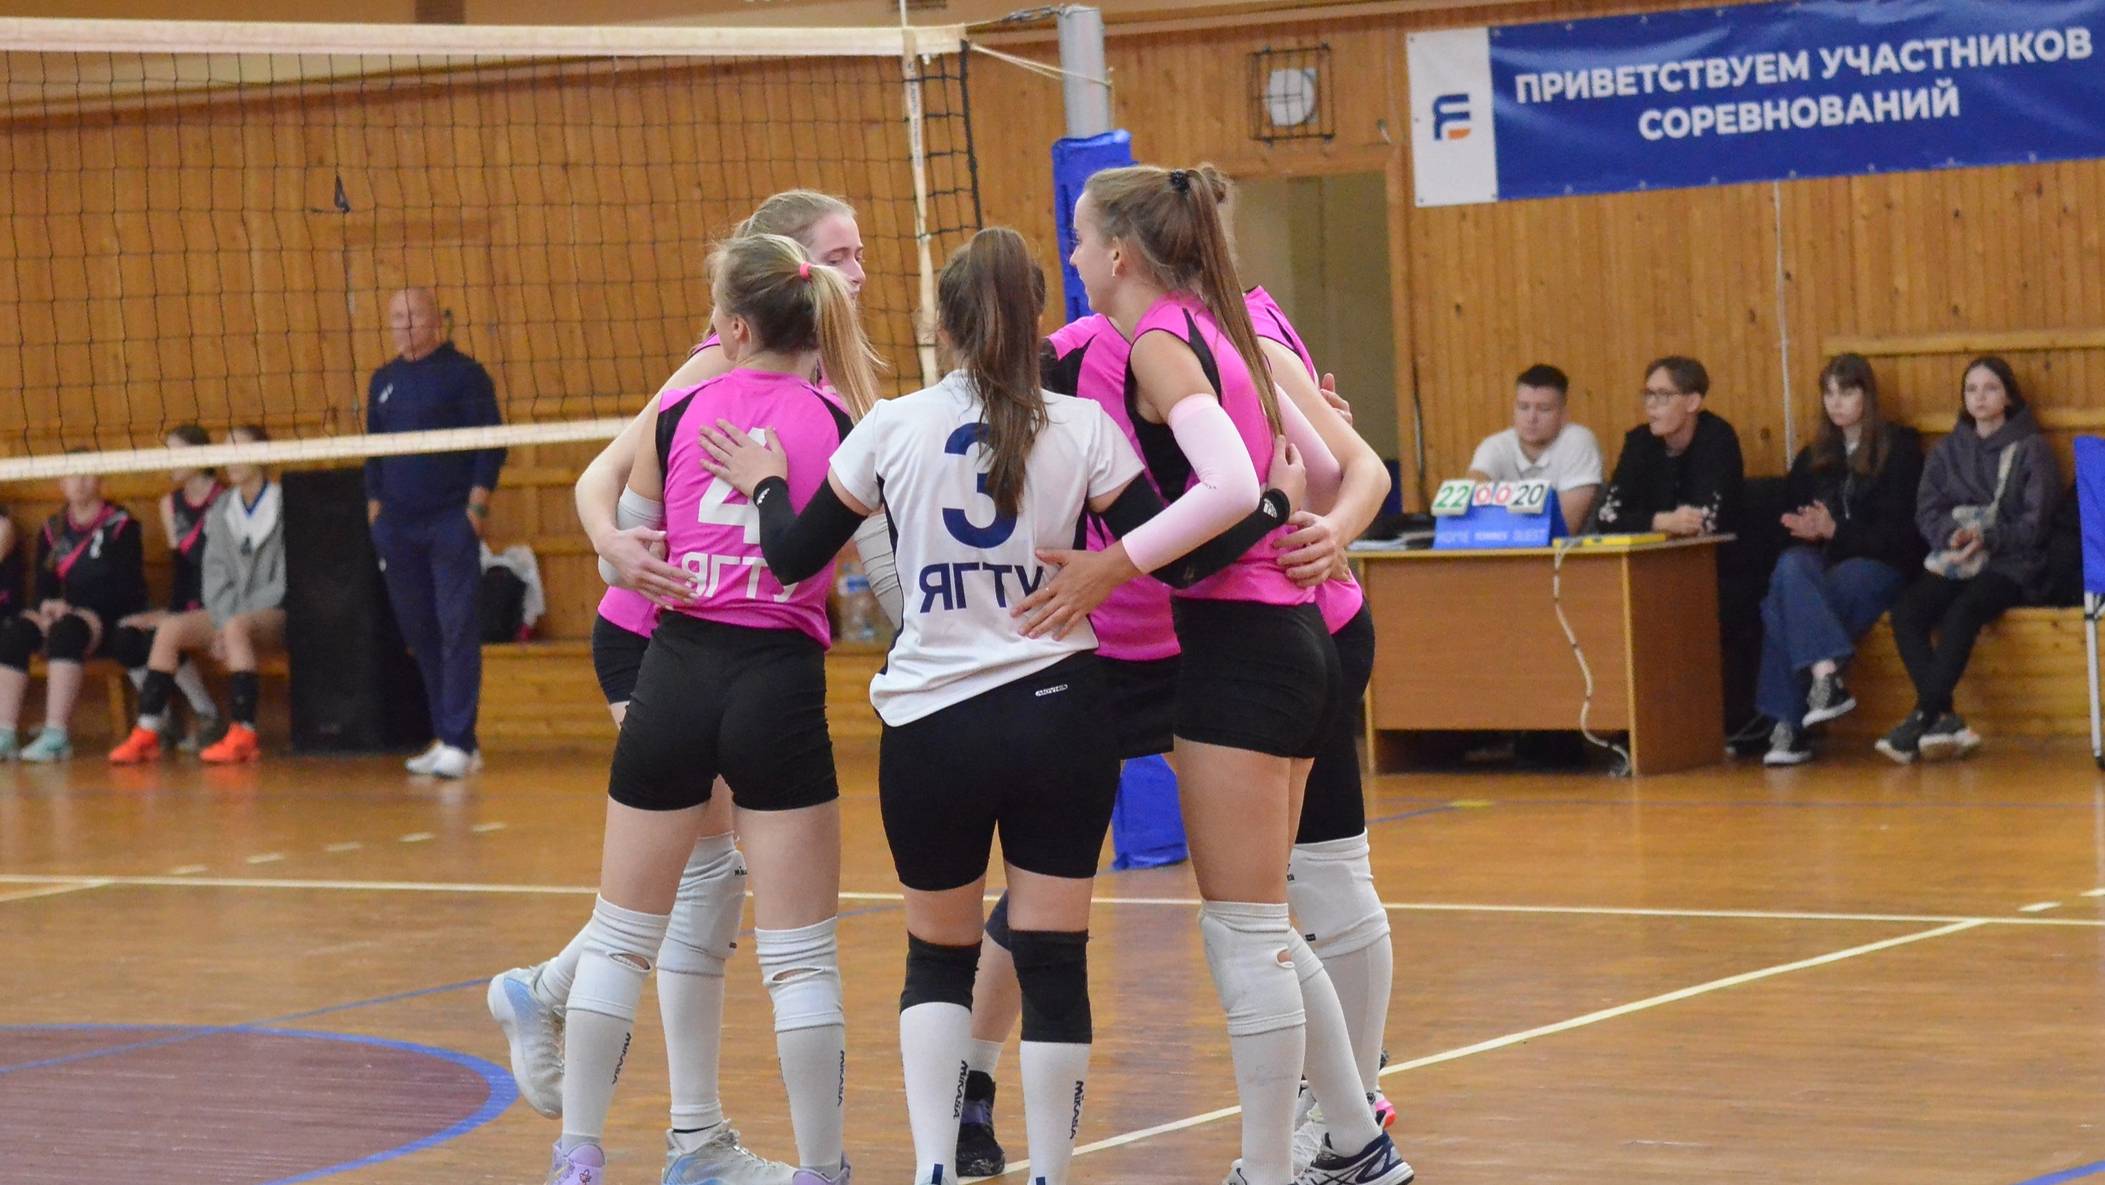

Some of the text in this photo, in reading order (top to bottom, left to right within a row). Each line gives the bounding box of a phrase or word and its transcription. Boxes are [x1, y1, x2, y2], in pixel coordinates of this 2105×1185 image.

[1515, 27, 2093, 104] ПРИВЕТСТВУЕМ УЧАСТНИКОВ
[1638, 77, 1960, 141] СОРЕВНОВАНИЙ
[942, 422, 1018, 549] 3
[1435, 485, 1470, 508] 22
[1512, 484, 1545, 506] 20
